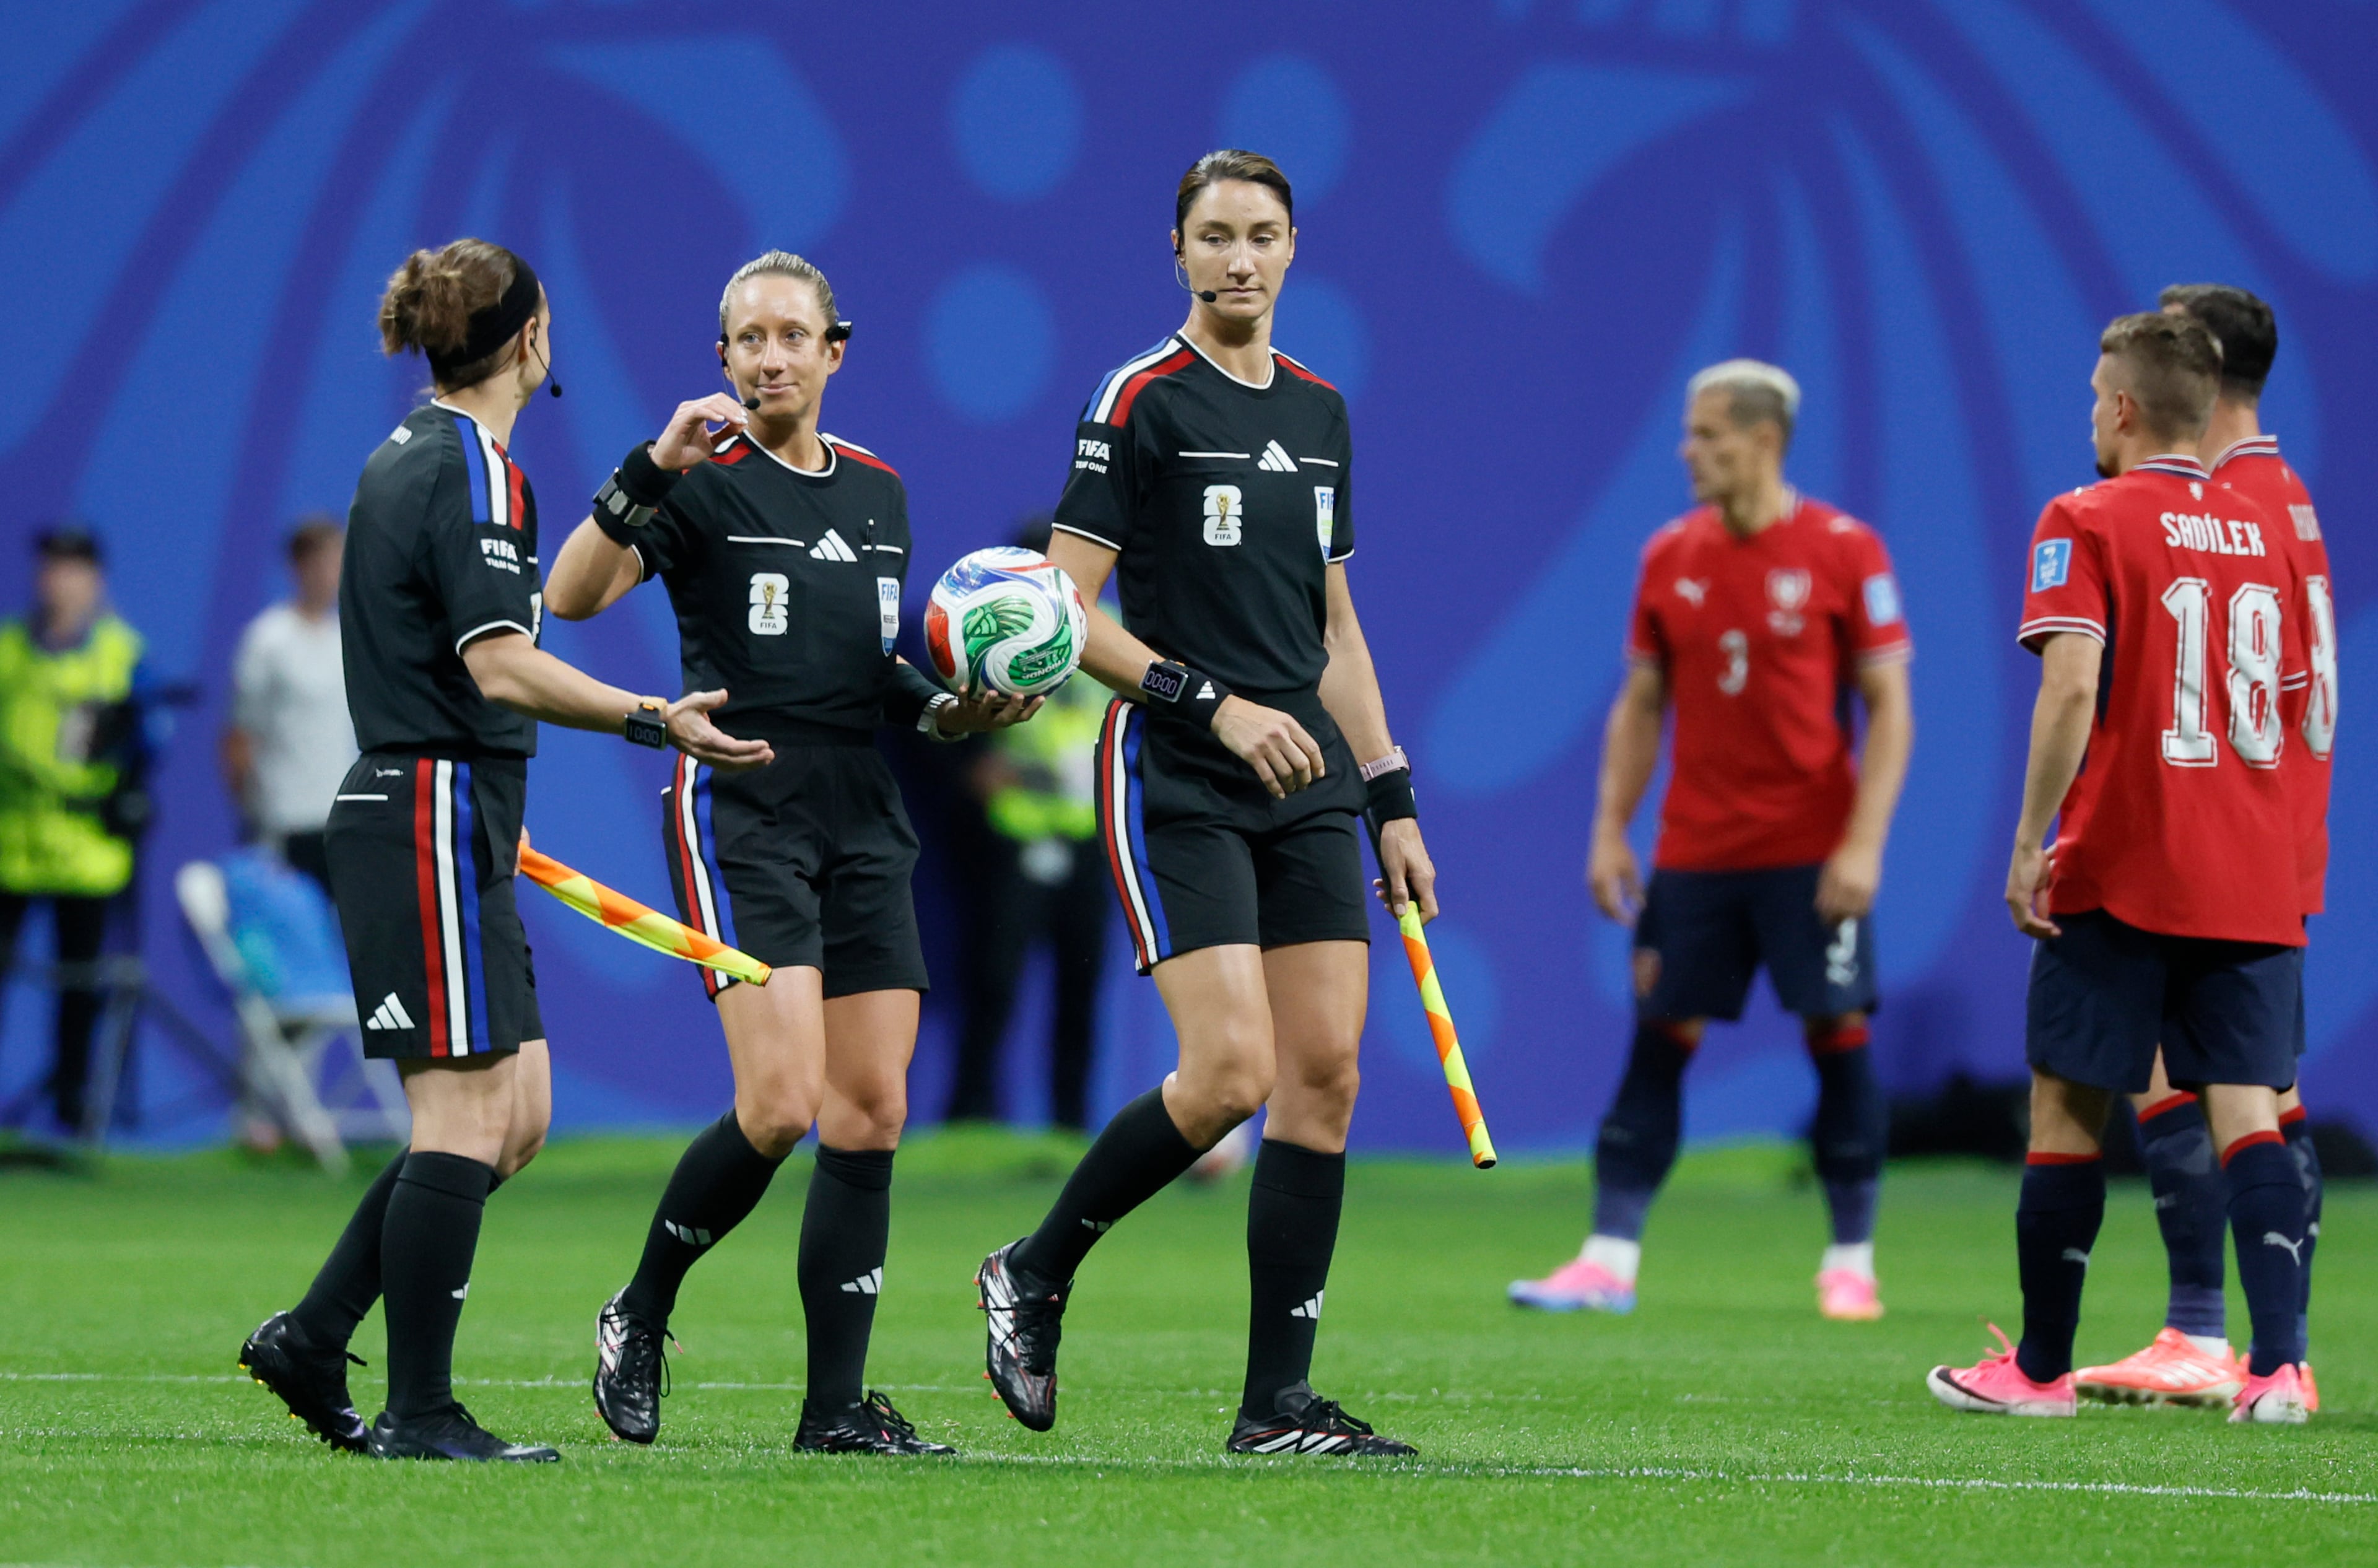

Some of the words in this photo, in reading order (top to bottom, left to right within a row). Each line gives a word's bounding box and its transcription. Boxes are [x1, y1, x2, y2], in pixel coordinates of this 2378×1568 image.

[1078, 438, 1110, 461] FIFA
[1088, 461, 1107, 474] ONE
[2160, 512, 2266, 557] SADÍLEK
[481, 539, 518, 562] FIFA
[881, 583, 898, 601] FIFA
[1718, 629, 1748, 695] 3
[2161, 577, 2284, 769] 18
[1145, 670, 1177, 694] 00:00
